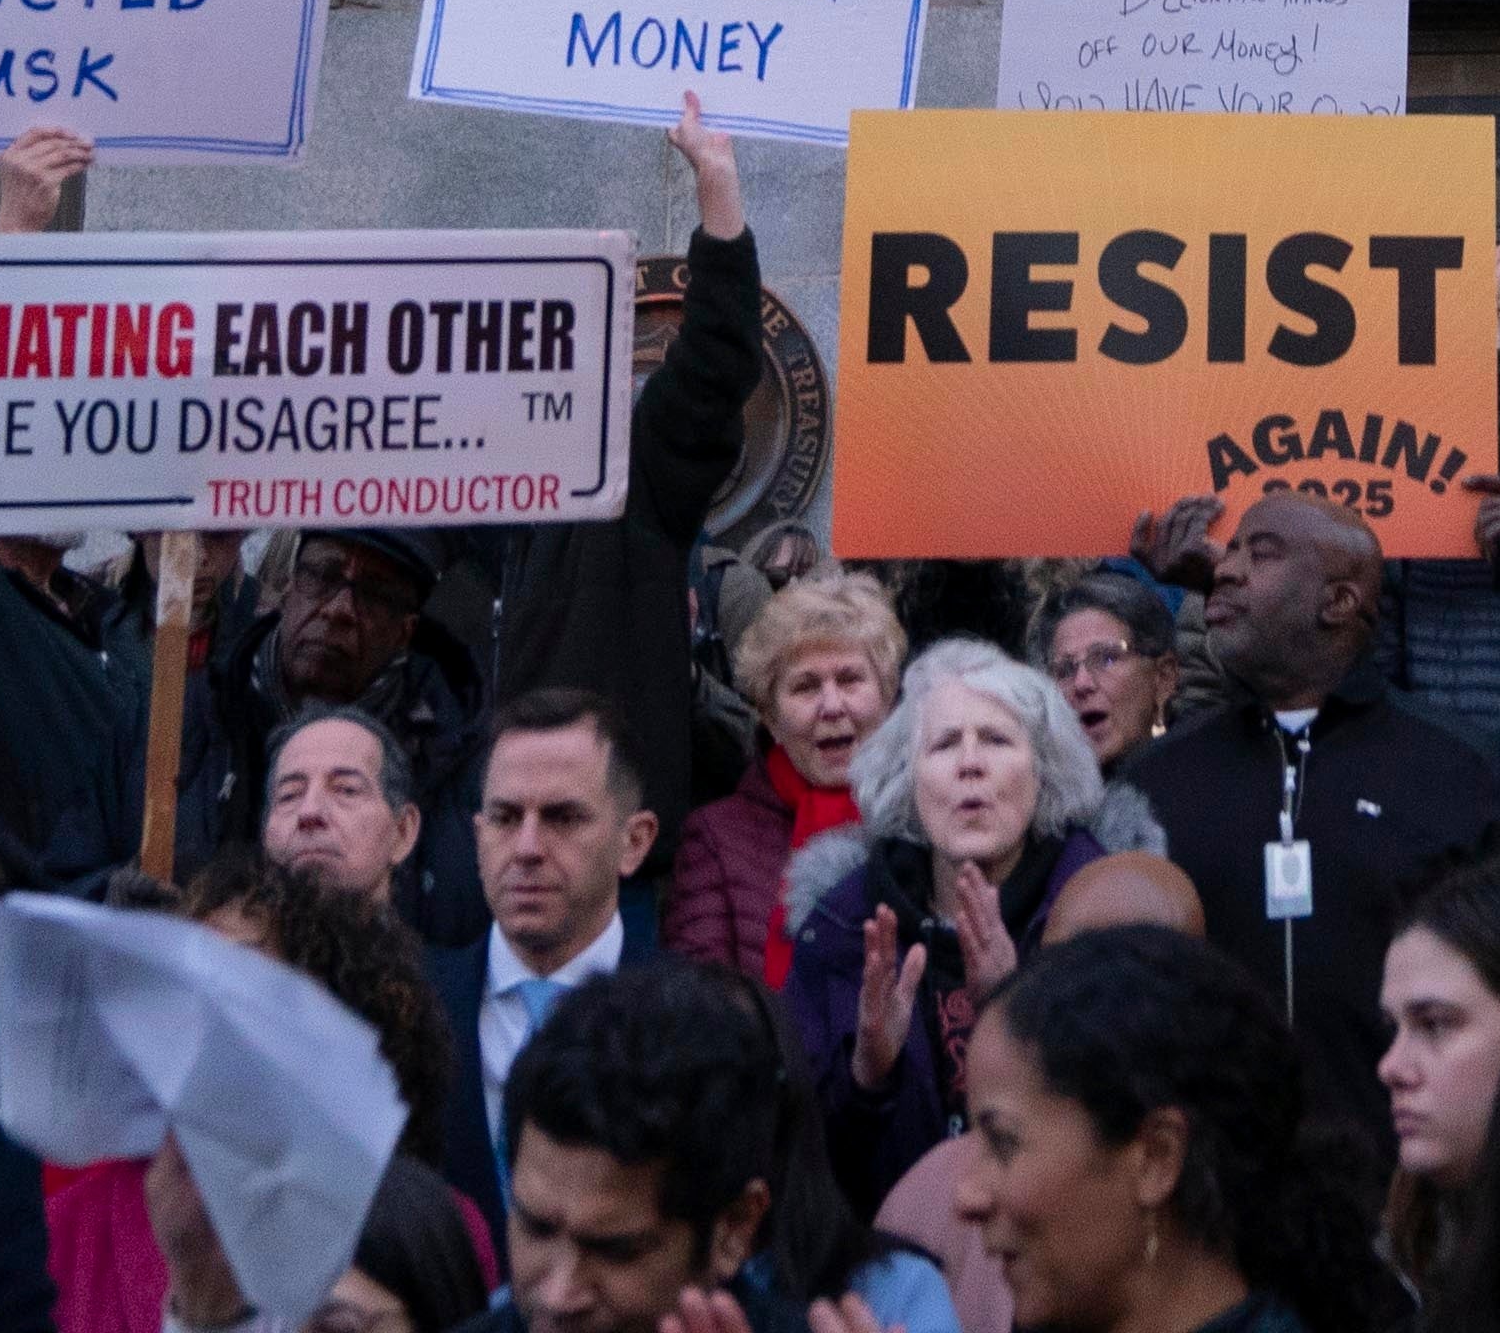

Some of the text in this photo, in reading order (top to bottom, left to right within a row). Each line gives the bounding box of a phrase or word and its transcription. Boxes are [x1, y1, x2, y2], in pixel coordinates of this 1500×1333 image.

[566, 11, 784, 82] MONEY
[1077, 34, 1119, 70] OFF
[1140, 32, 1203, 58] OUR
[866, 228, 1465, 367] RESIST
[213, 300, 370, 377] EACH
[387, 297, 576, 375] OTHER
[52, 399, 160, 455] YOU
[177, 393, 486, 453] DISAGREE...
[521, 391, 573, 422] TM
[1207, 408, 1468, 495] AGAIN!
[207, 473, 561, 518] TRUTH CONDUCTOR
[1261, 478, 1394, 518] 25
